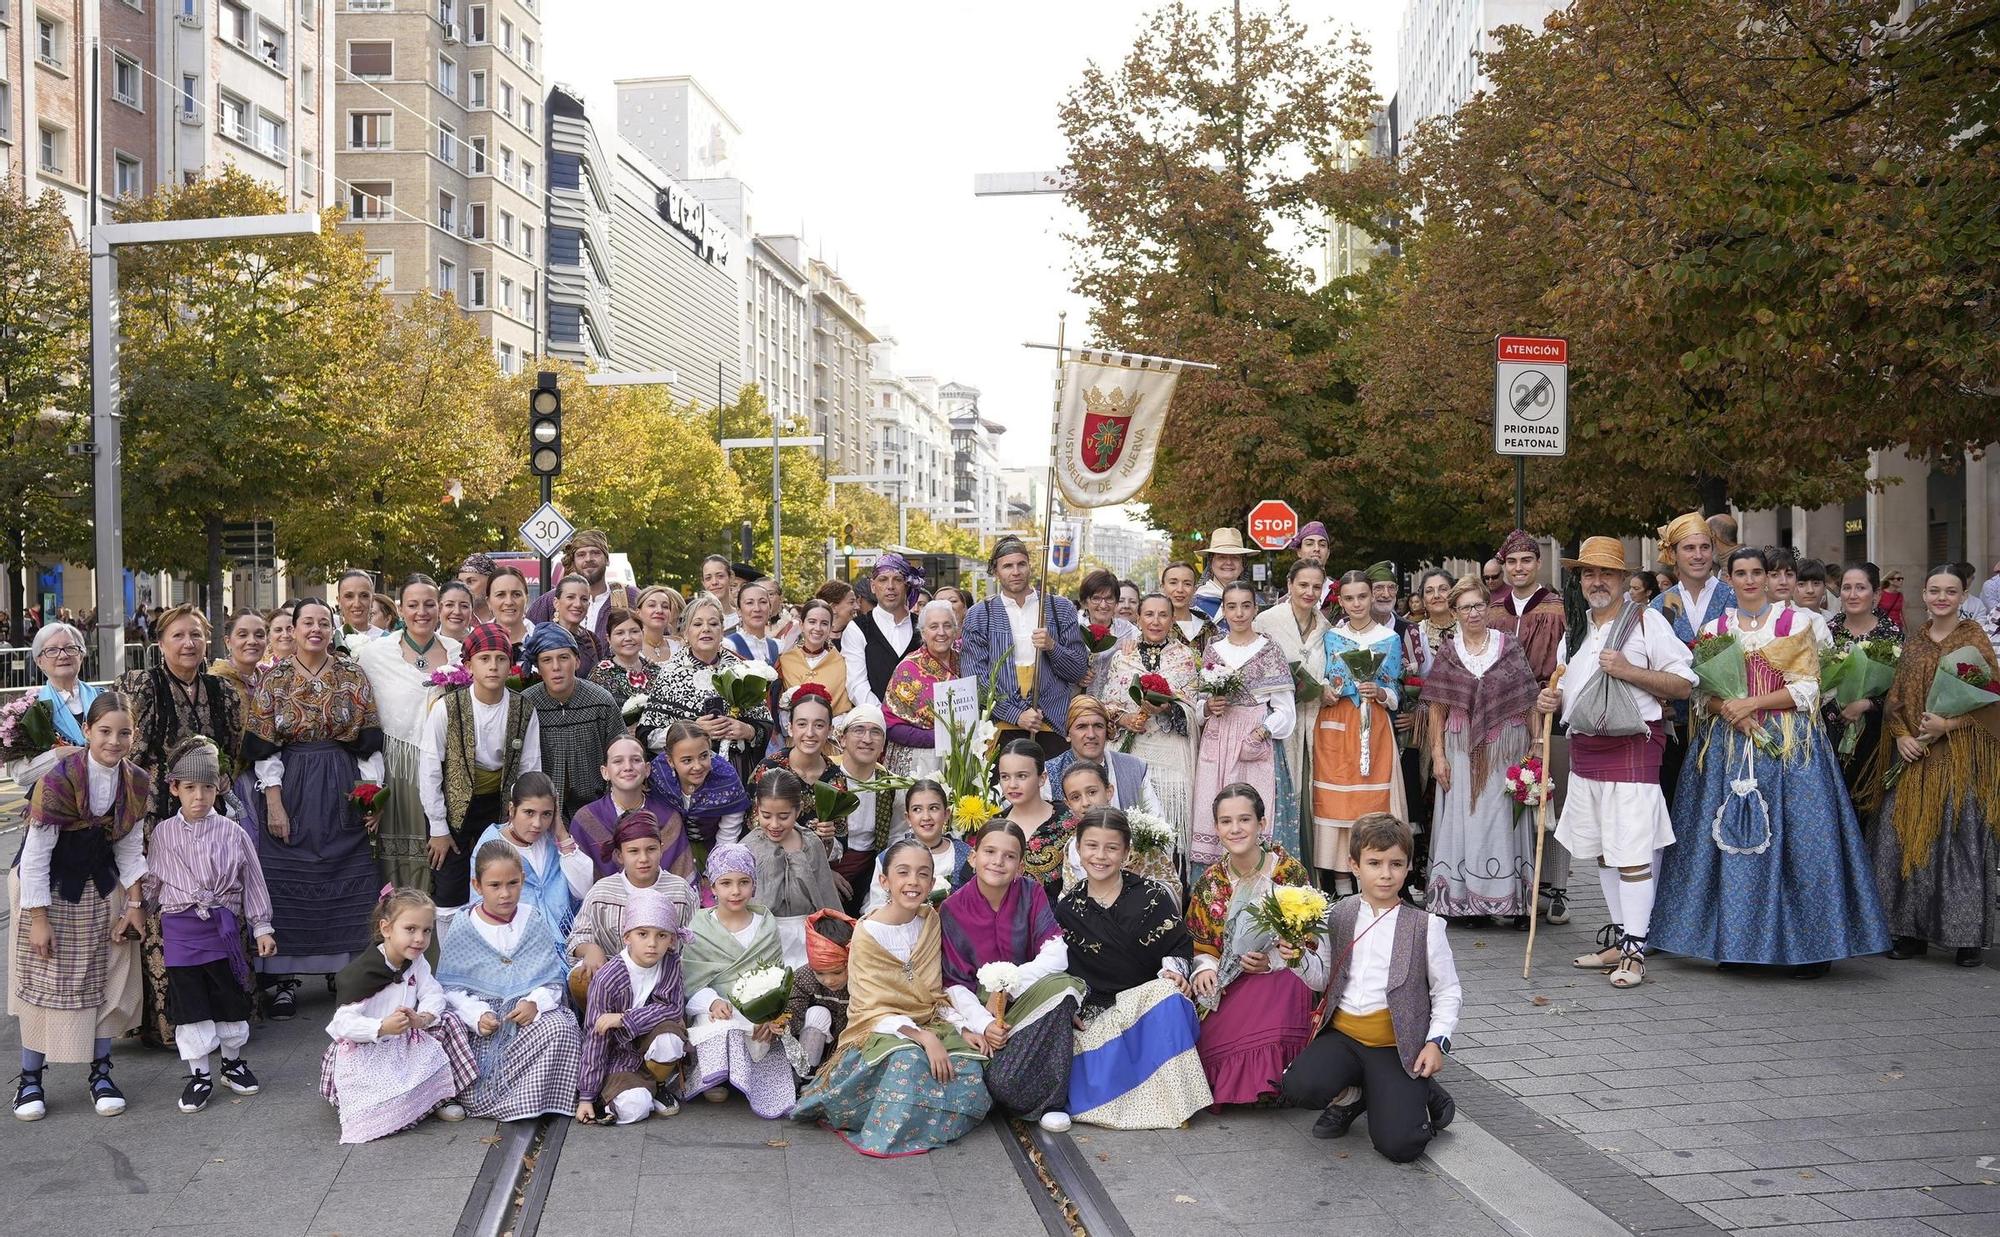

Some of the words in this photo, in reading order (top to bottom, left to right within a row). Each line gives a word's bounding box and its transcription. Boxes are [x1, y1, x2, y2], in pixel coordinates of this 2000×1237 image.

[1505, 344, 1559, 355] ATENCIÓN
[1515, 384, 1550, 408] 20
[1504, 425, 1559, 435] PRIORIDAD
[1505, 438, 1558, 448] PEATONAL
[1065, 428, 1089, 492] VISTABELLA
[1098, 480, 1112, 493] DE
[1120, 428, 1145, 477] HUERVA
[535, 520, 559, 539] 30
[1254, 519, 1292, 531] STOP
[936, 696, 974, 707] VISABELLA
